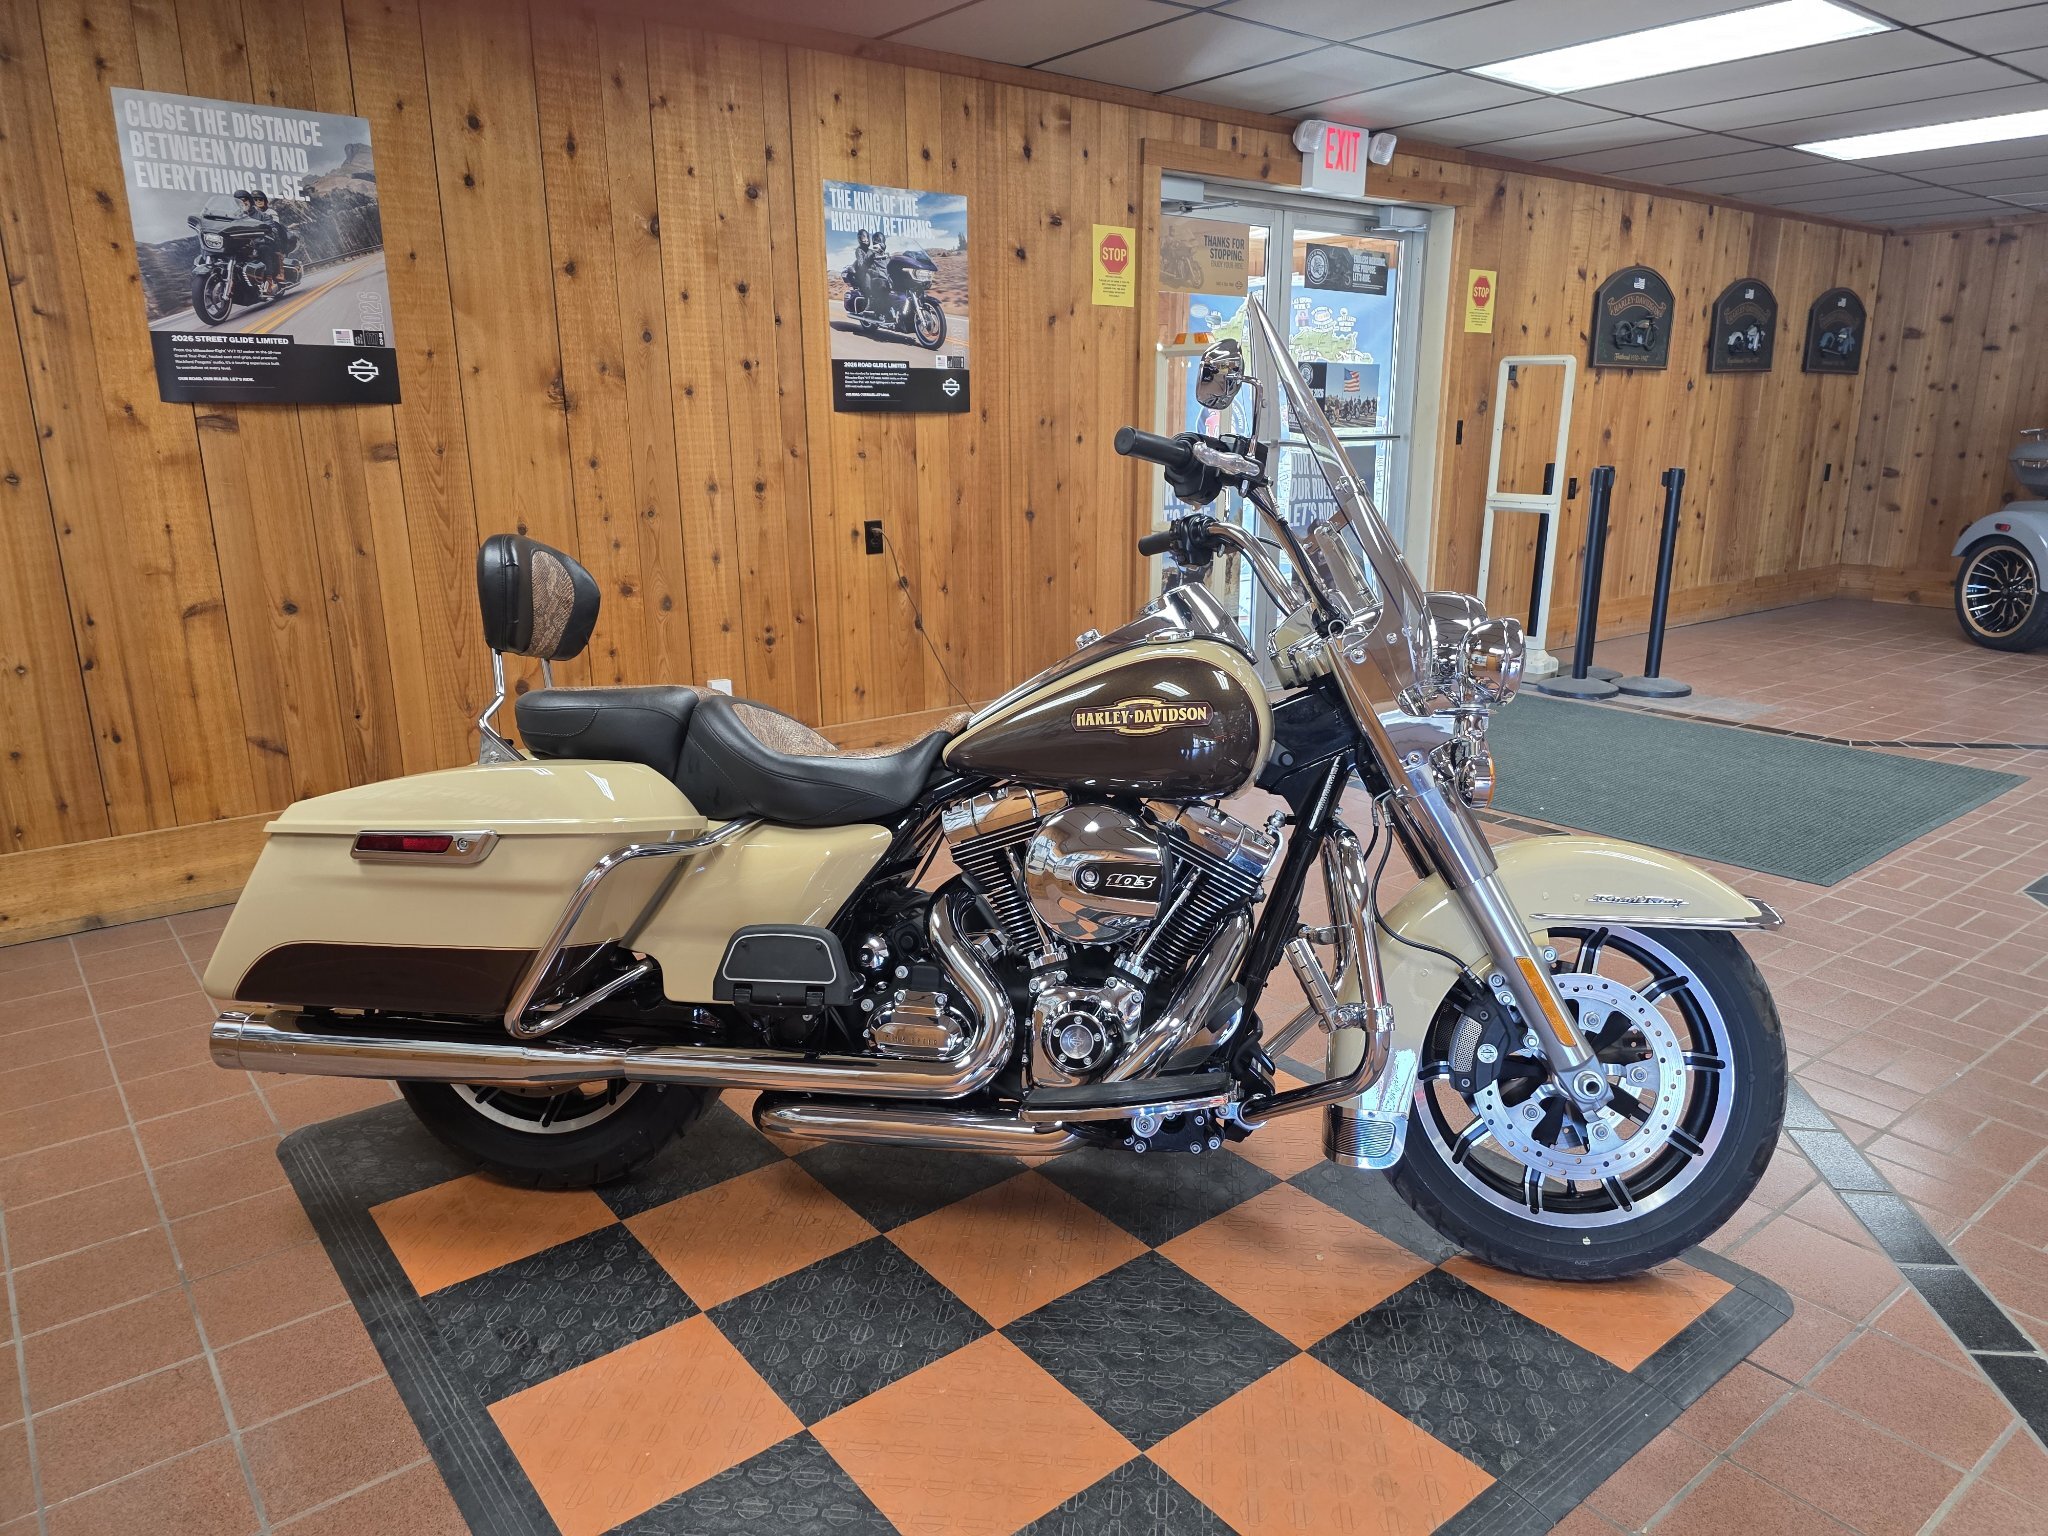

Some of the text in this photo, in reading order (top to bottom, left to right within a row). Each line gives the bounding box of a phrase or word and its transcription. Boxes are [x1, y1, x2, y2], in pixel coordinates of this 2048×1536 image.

[124, 100, 323, 147] CLOSE THE DISTANCE
[128, 130, 309, 174] BETWEEN YOU AND
[1325, 127, 1361, 173] EXIT
[133, 160, 311, 202] EVERYTHING ELSE.
[829, 187, 919, 217] THE KING OF THE
[831, 211, 935, 240] HIGHWAY RETURNS.
[1204, 235, 1245, 249] THANKS FOR
[1102, 247, 1127, 262] STOP
[1210, 248, 1244, 261] STOPPING.
[1474, 286, 1490, 298] STOP
[195, 335, 227, 343] STREET
[229, 336, 255, 344] GLIDE
[256, 337, 289, 345] LIMITED
[1292, 453, 1310, 475] OUR
[1291, 478, 1311, 502] OUR
[1289, 502, 1317, 527] LET'S
[1076, 706, 1207, 727] HARLEY-DAVIDSON
